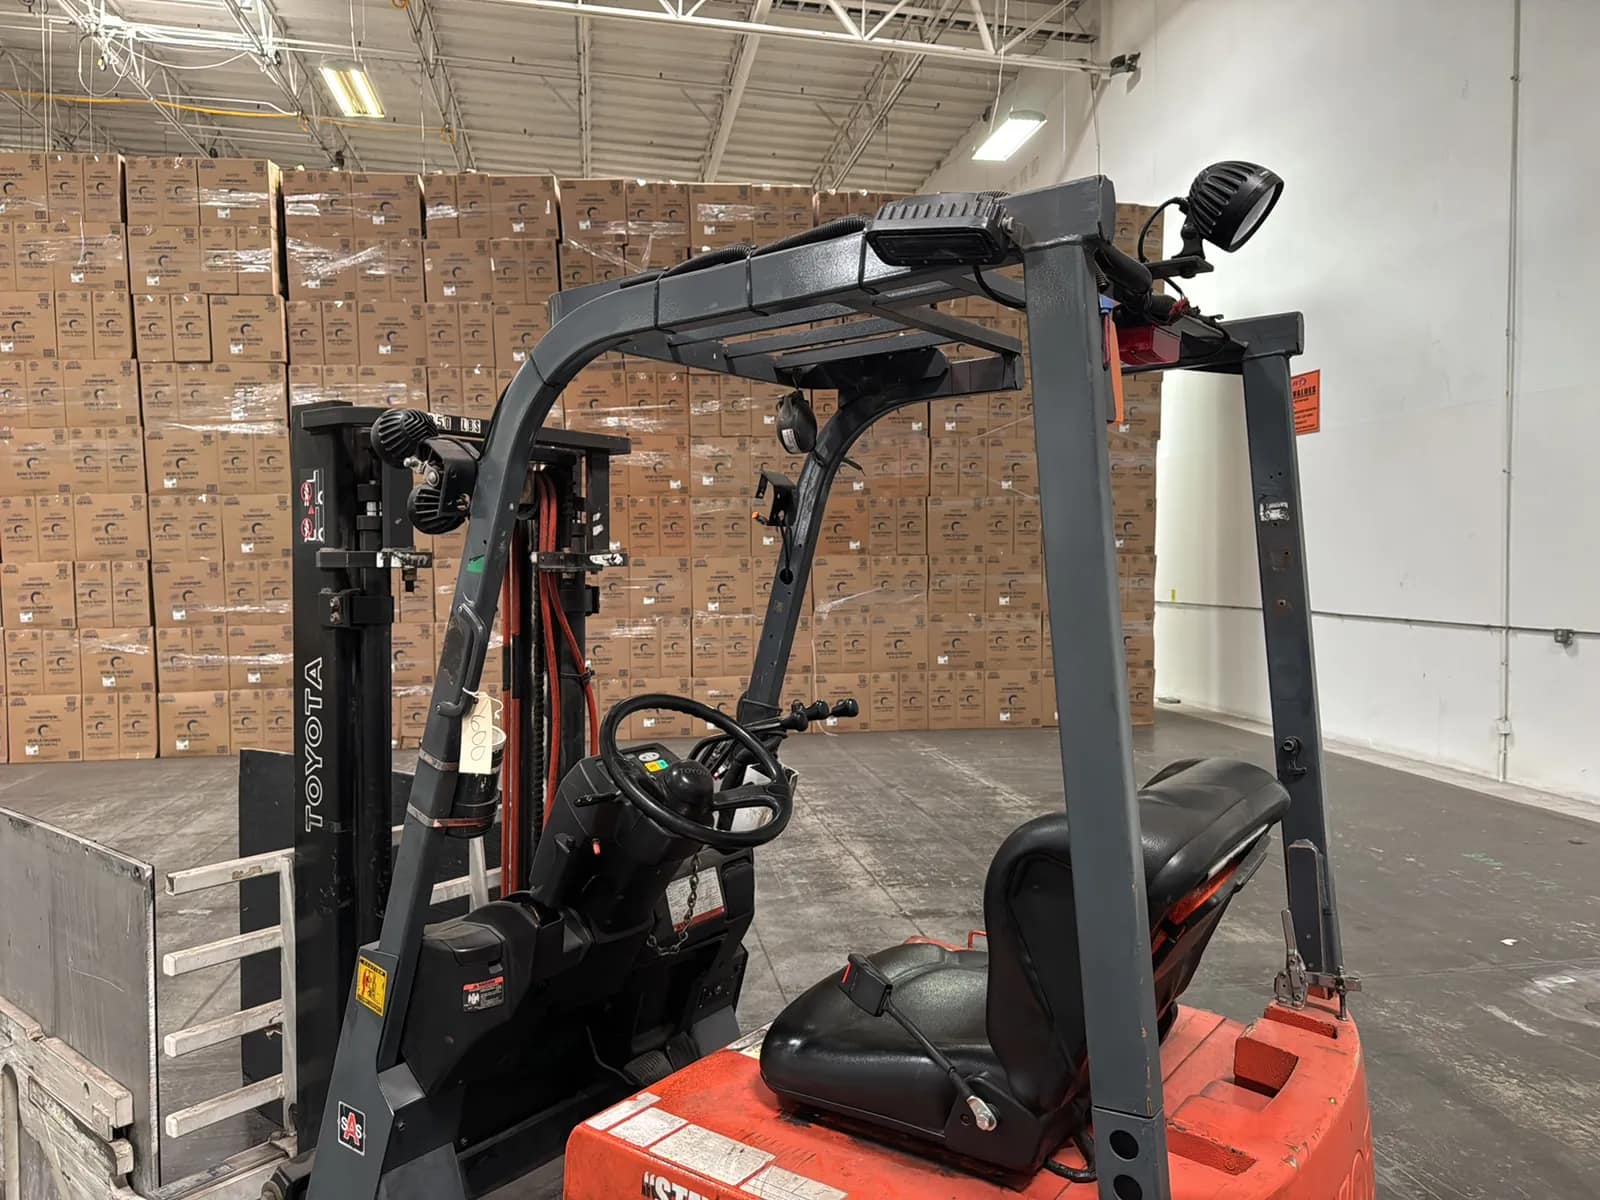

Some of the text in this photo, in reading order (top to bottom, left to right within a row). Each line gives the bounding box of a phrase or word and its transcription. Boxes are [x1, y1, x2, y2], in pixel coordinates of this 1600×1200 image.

[462, 418, 480, 432] LBS
[304, 656, 323, 833] TOYOTA
[341, 1112, 362, 1146] SAS
